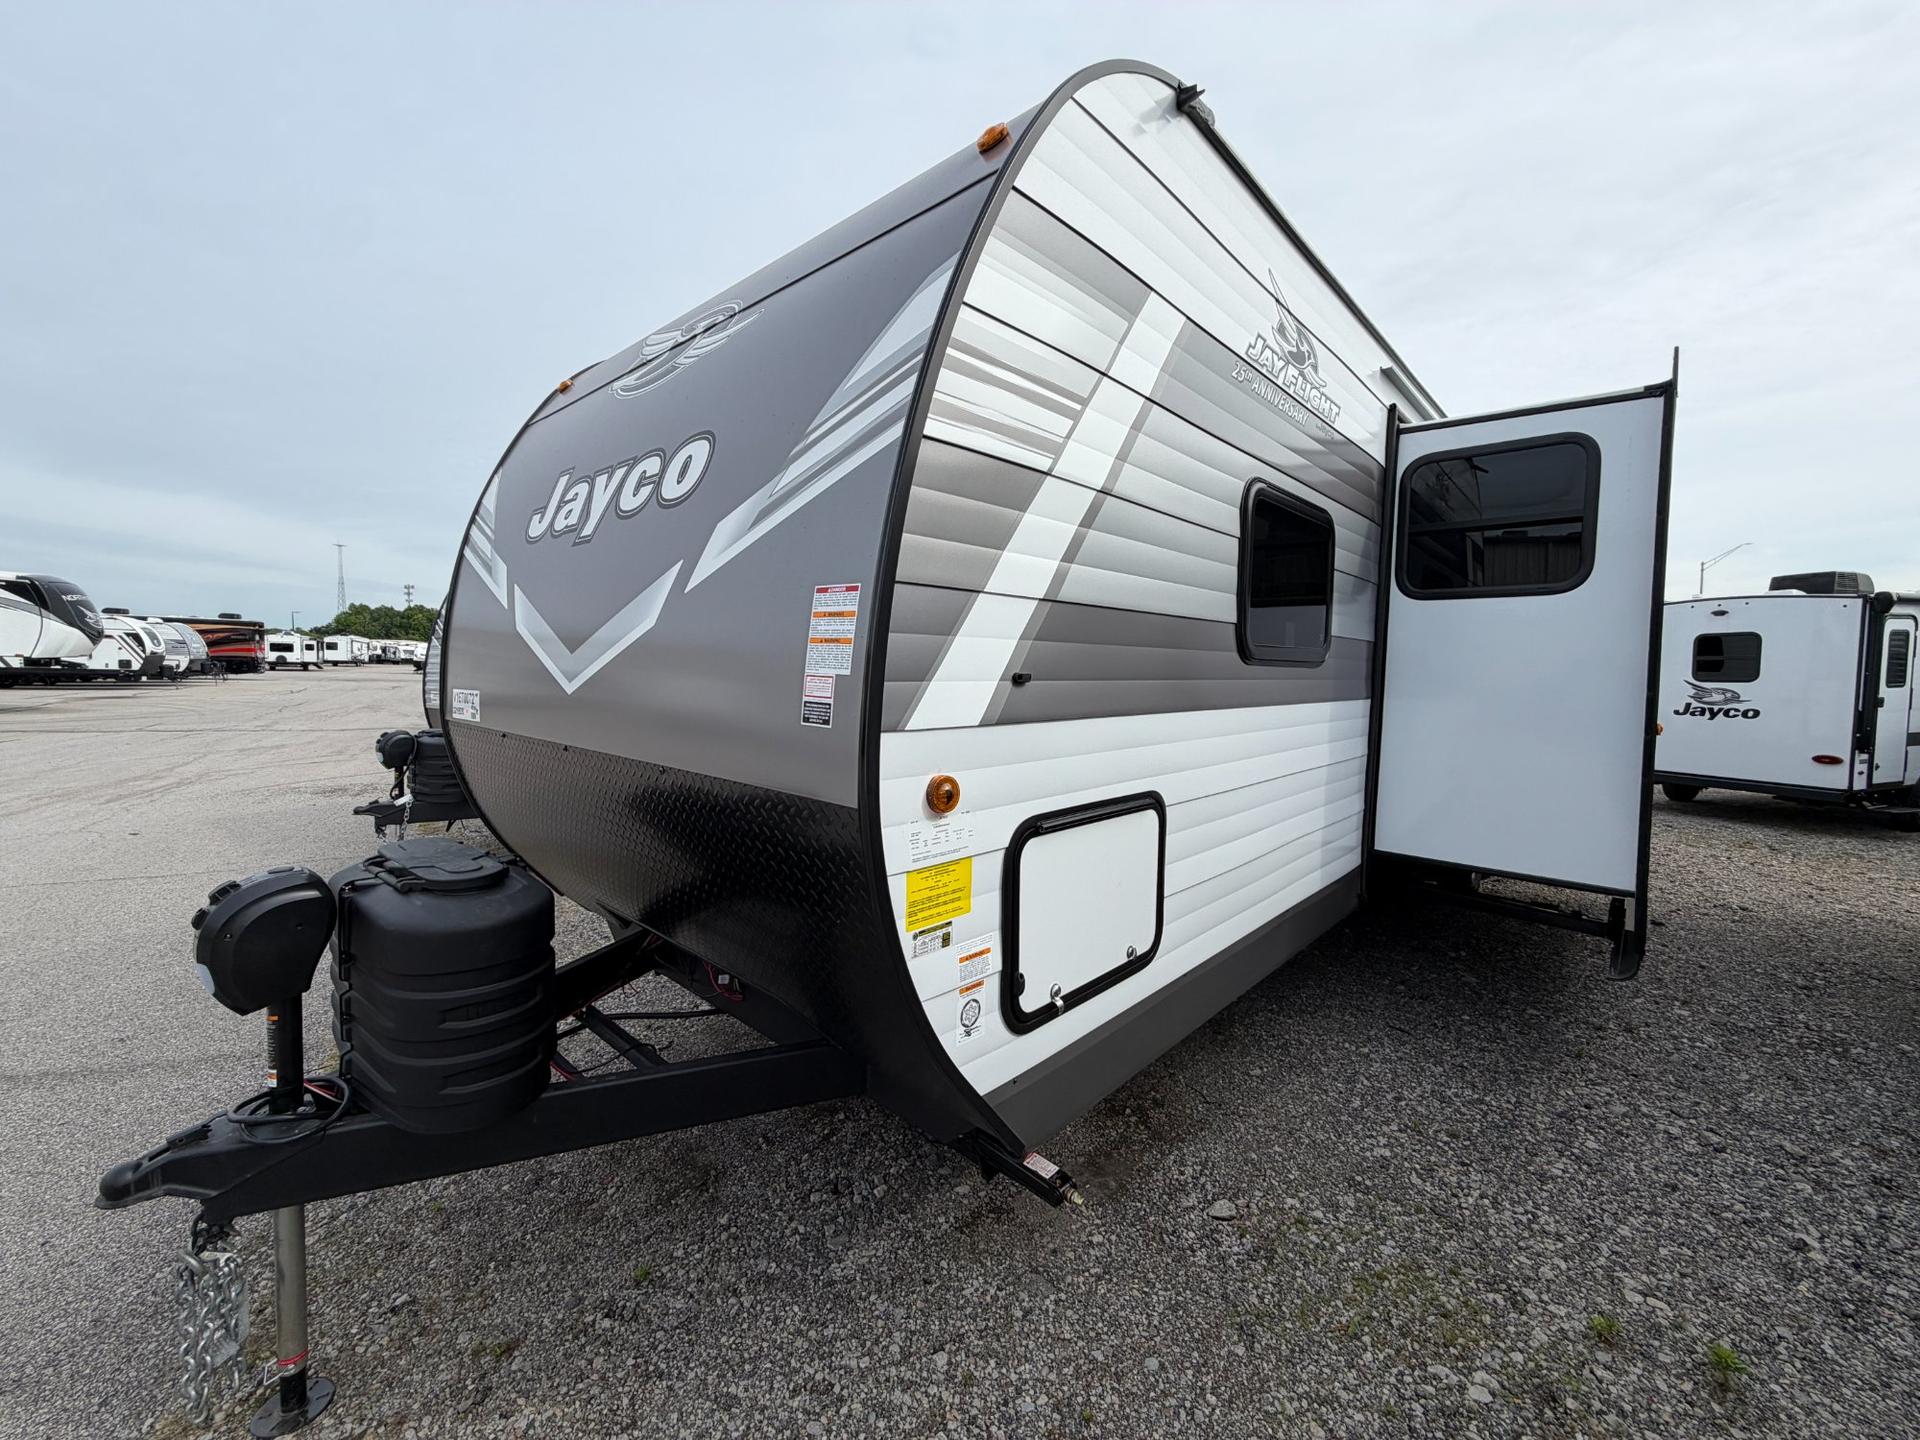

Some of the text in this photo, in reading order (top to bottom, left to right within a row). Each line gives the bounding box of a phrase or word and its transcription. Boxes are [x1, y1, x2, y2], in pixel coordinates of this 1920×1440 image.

[1231, 360, 1309, 425] 25th ANNIVERSARY
[1245, 333, 1341, 424] JAY FLIGHT
[526, 431, 716, 546] Jayco
[1673, 702, 1760, 720] Jayco
